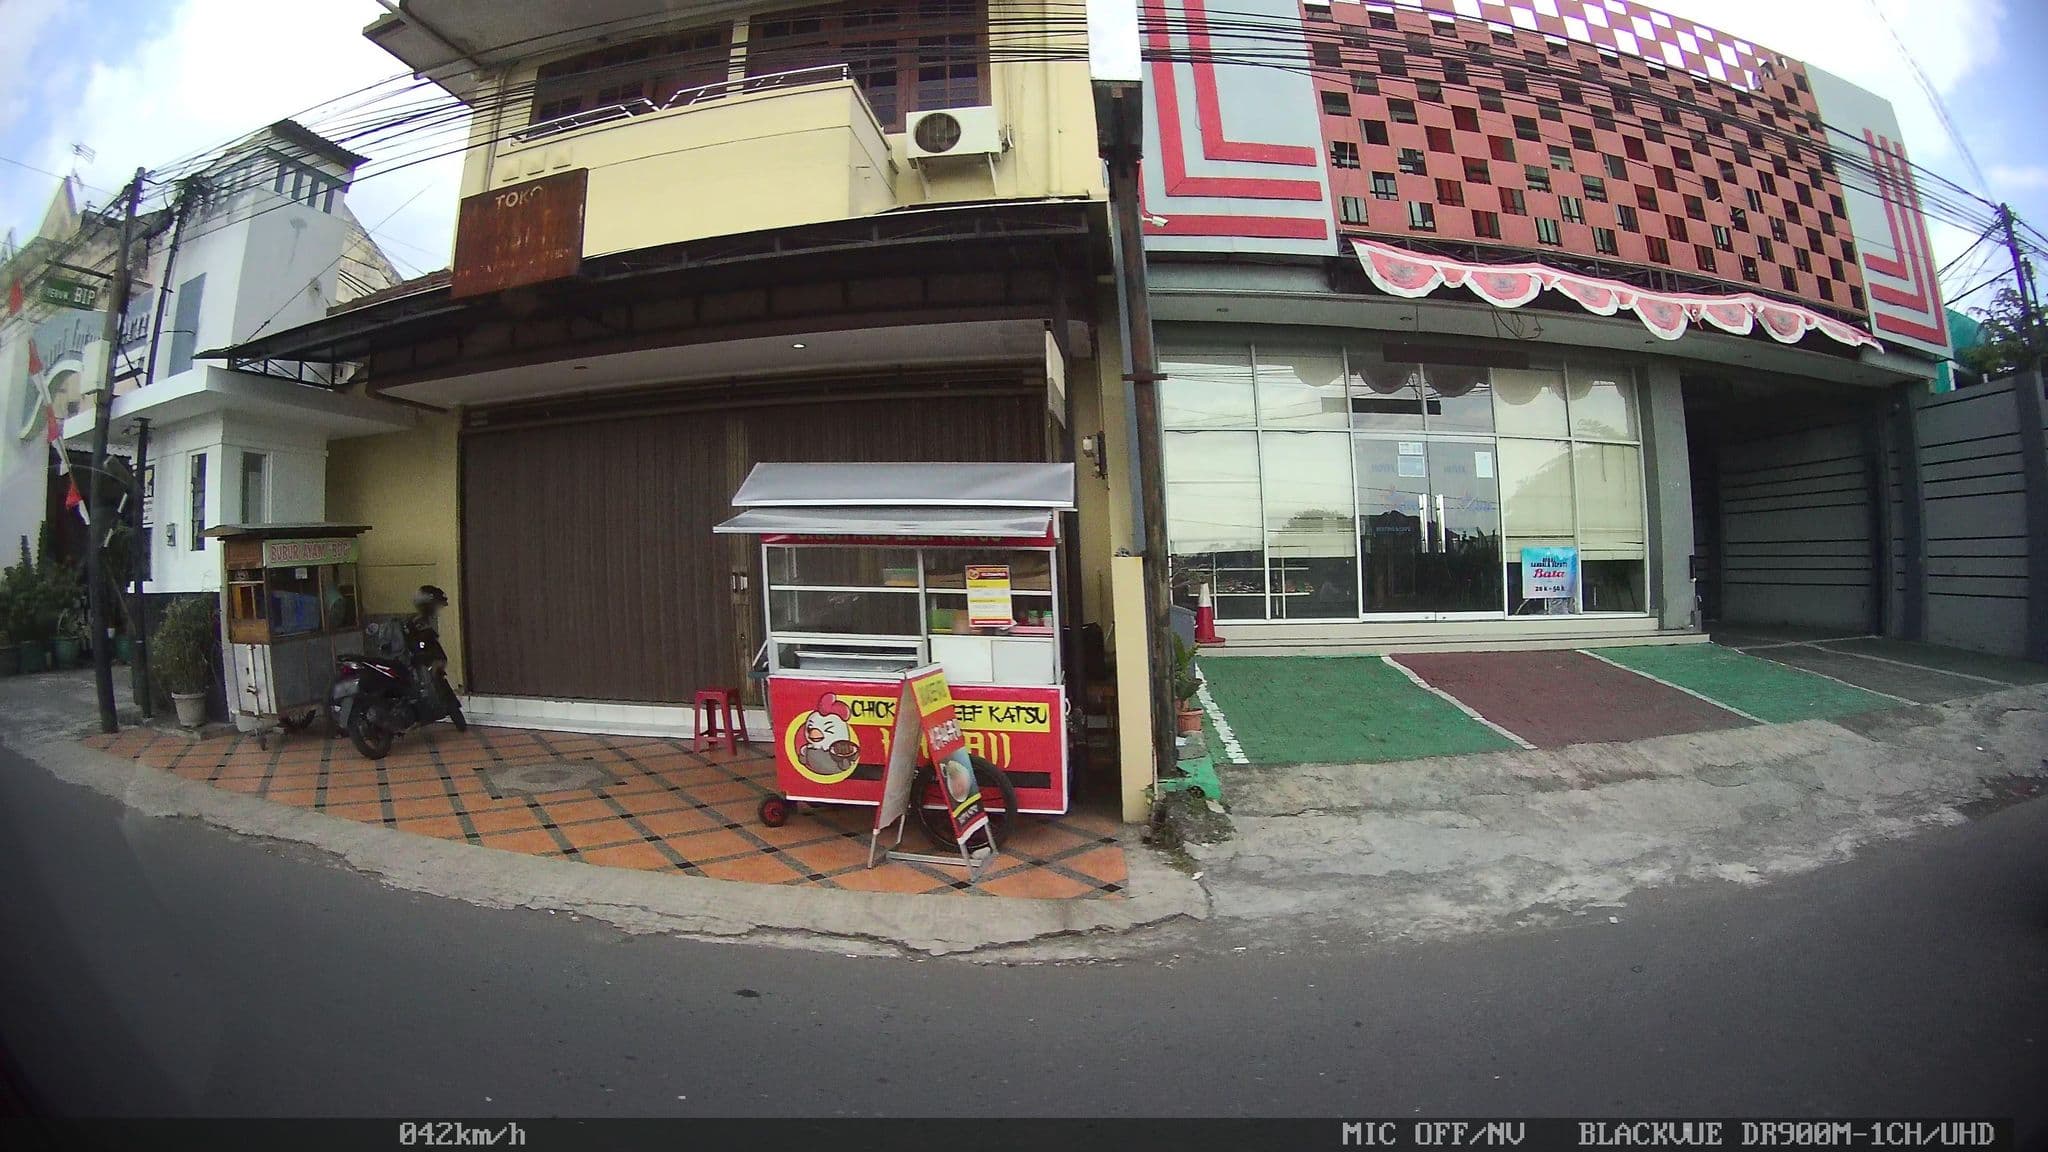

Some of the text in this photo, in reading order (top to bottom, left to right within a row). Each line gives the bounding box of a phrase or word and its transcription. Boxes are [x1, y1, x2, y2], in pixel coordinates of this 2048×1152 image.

[271, 543, 299, 562] BUBUR
[303, 542, 326, 560] AYAM
[1533, 568, 1565, 578] Bata
[851, 700, 1048, 724] CHICK EEF KATSU
